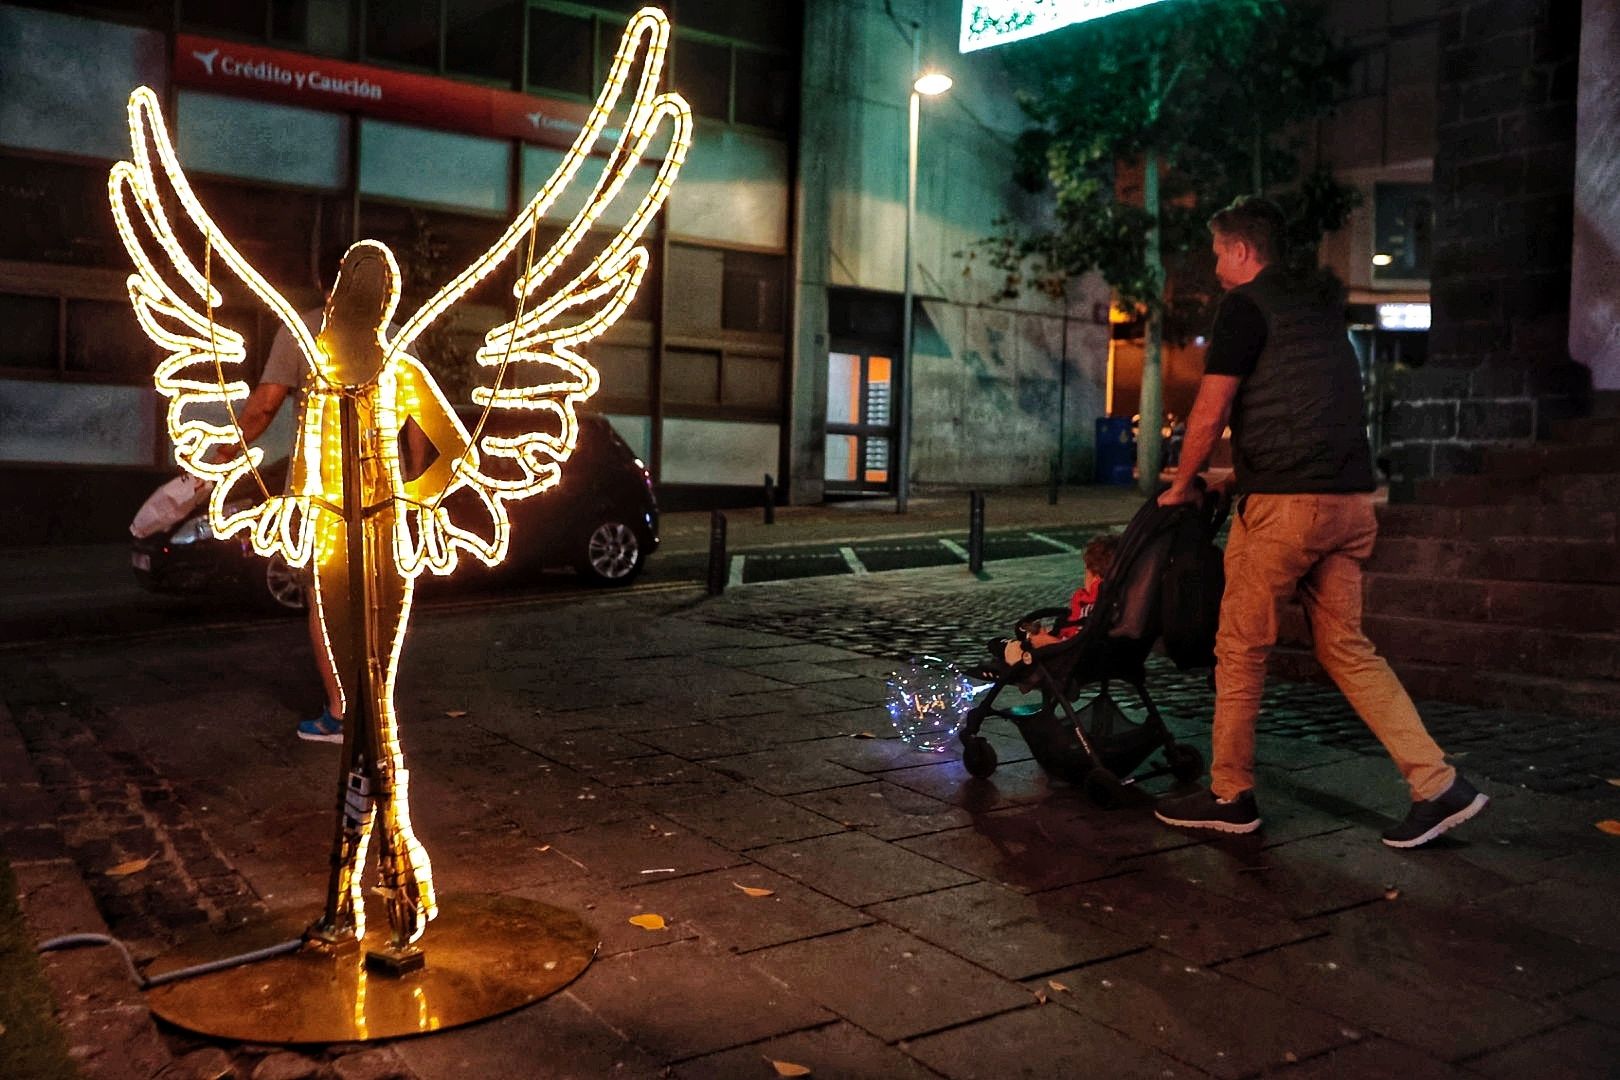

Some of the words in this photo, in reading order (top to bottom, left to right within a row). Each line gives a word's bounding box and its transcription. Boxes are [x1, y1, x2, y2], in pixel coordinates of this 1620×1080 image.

[221, 56, 292, 84] Crédito
[294, 70, 306, 90] y
[308, 70, 382, 100] Caución
